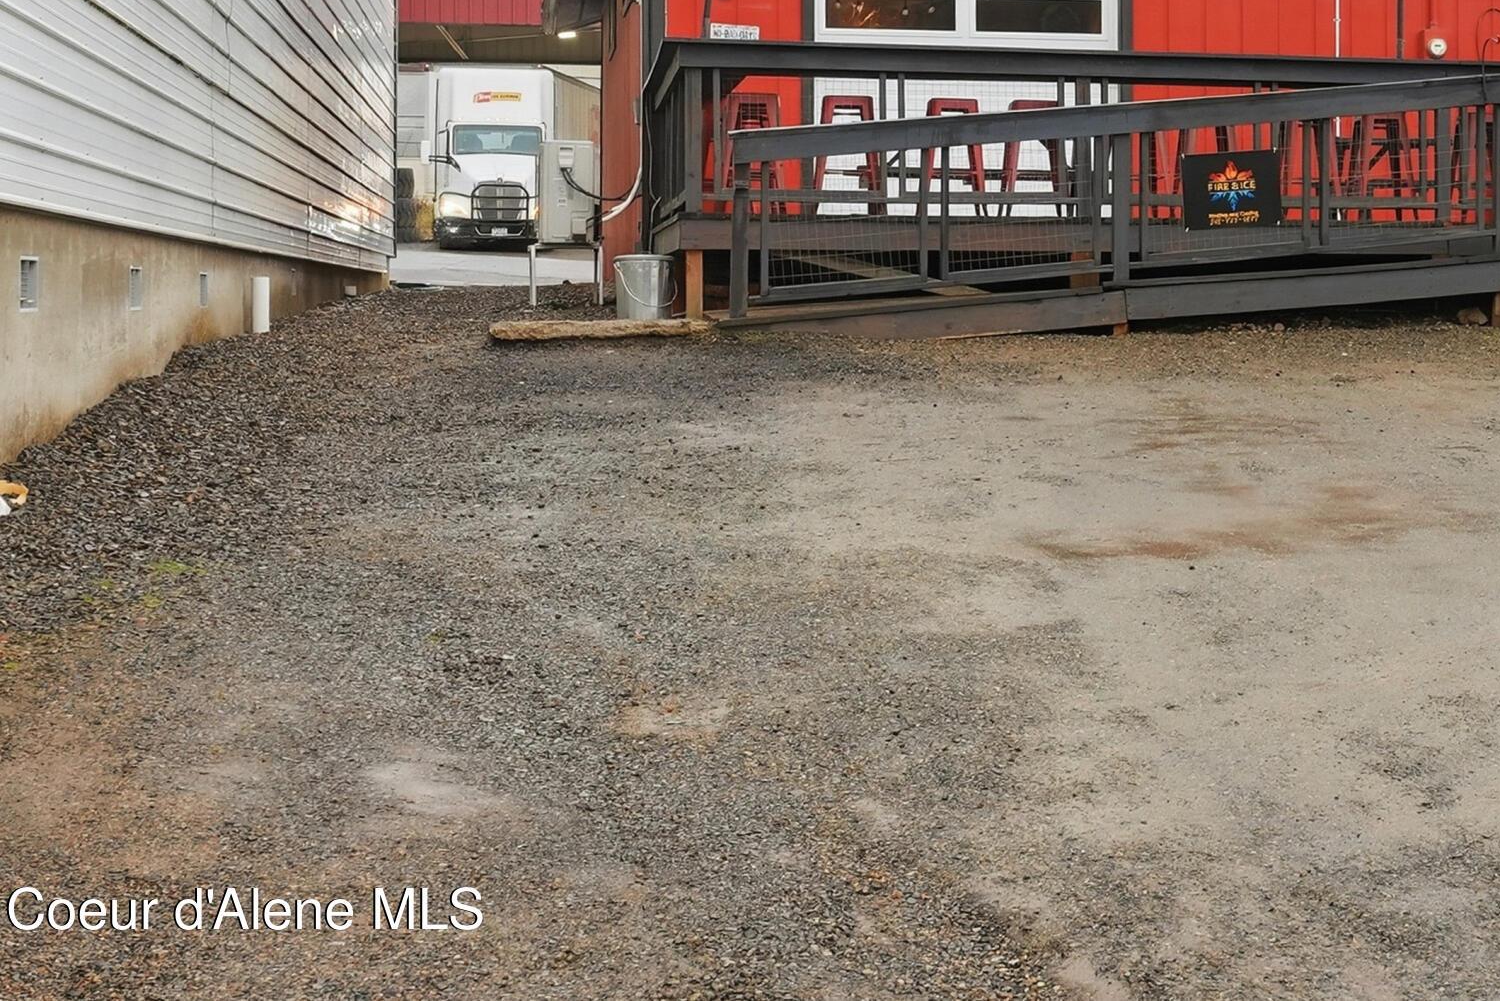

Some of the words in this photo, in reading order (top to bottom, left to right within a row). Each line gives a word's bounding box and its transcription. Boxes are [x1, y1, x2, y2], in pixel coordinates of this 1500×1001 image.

[1207, 182, 1229, 191] FIRE
[1231, 181, 1239, 190] &
[1240, 180, 1256, 189] ICE
